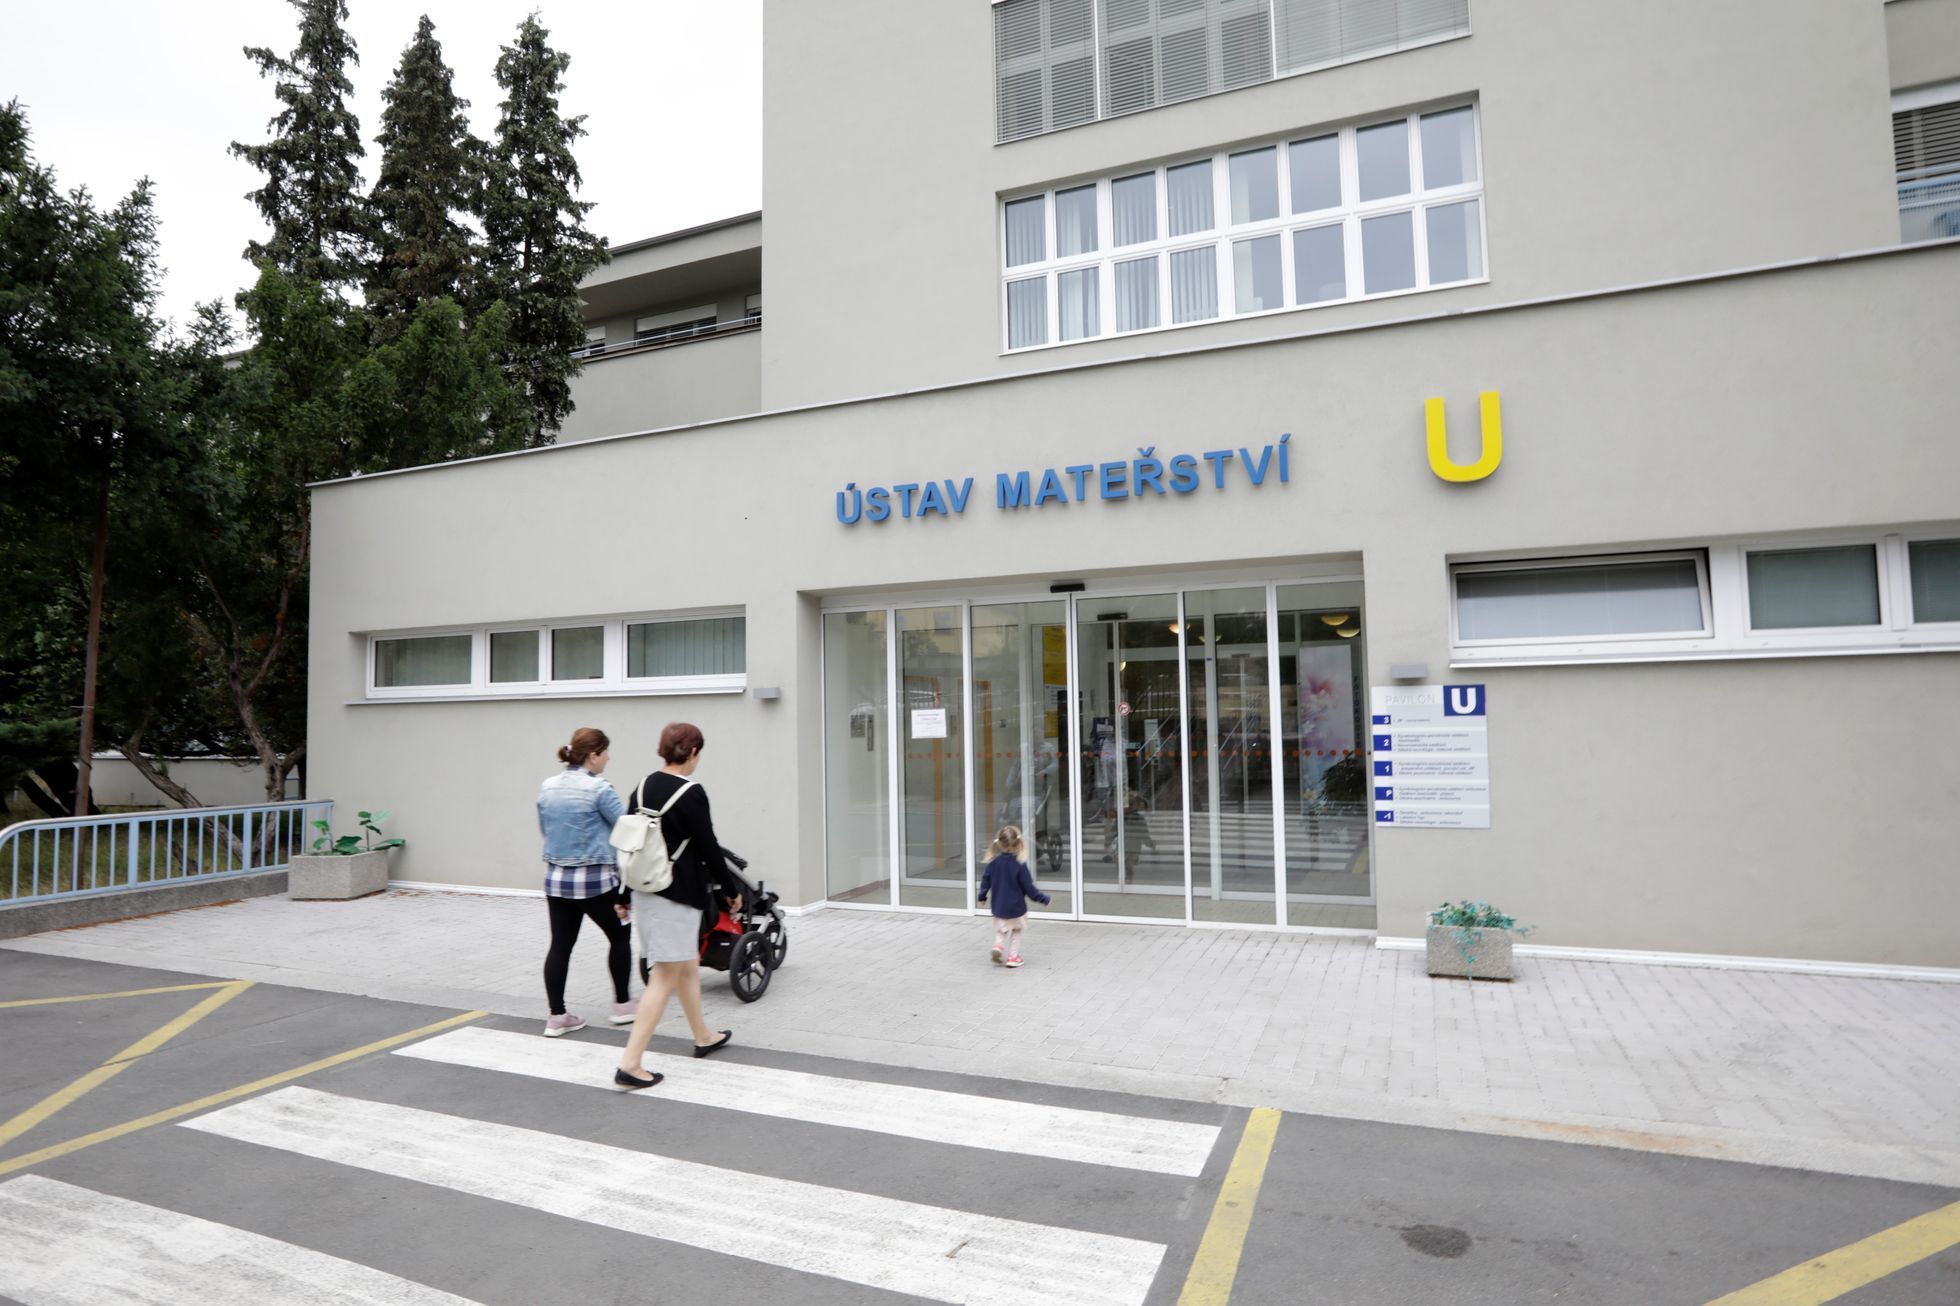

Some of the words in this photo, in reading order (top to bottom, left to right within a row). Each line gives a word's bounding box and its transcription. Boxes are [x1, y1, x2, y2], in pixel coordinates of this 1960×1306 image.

[836, 478, 973, 526] ÚSTAV
[996, 433, 1291, 510] MATEŘSTVÍ
[1425, 391, 1503, 483] U
[1385, 694, 1435, 704] PAVILON
[1451, 687, 1477, 714] U
